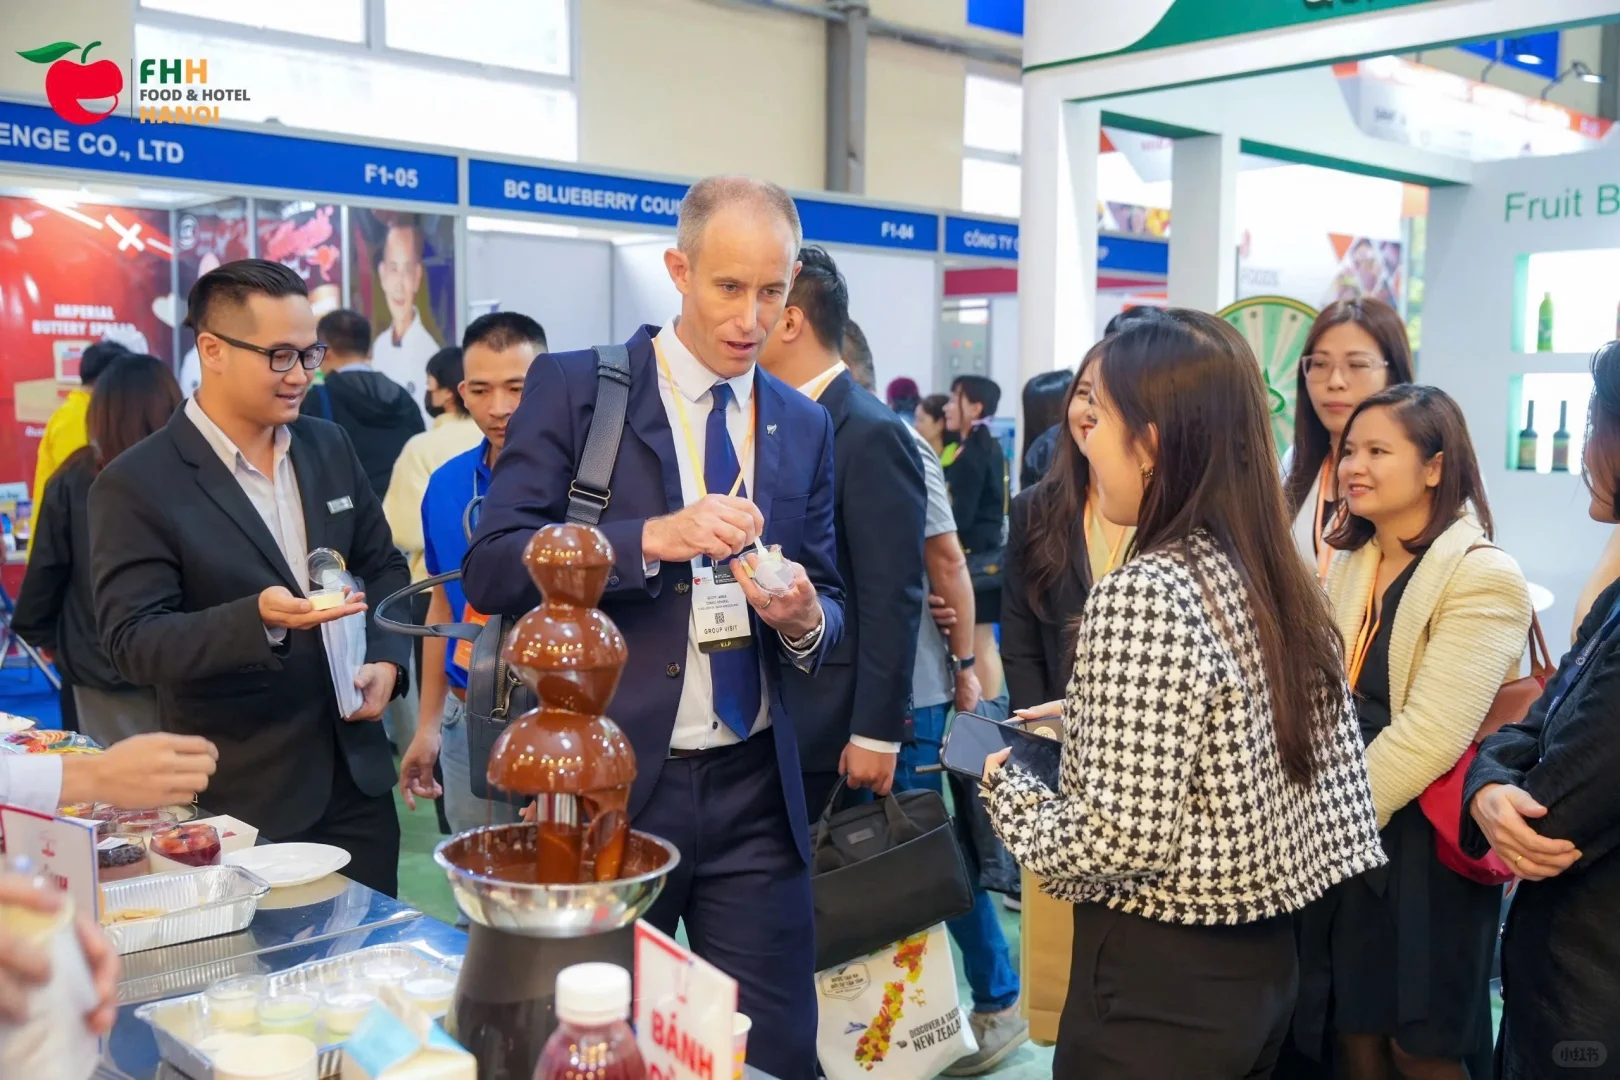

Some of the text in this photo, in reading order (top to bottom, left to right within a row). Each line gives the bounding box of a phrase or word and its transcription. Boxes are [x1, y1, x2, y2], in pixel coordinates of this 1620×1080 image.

[78, 132, 131, 162] CO.,
[137, 138, 185, 164] LTD
[364, 163, 418, 189] F1-05
[504, 179, 530, 200] BC
[534, 183, 638, 211] BLUEBERRY
[1504, 187, 1583, 223] Fruit
[998, 233, 1013, 251] TY
[704, 624, 738, 635] GROUP VISIT
[909, 1018, 941, 1039] DISCOVER
[940, 1016, 946, 1025] A
[652, 1010, 713, 1080] BÁNH
[912, 1032, 935, 1052] NEW
